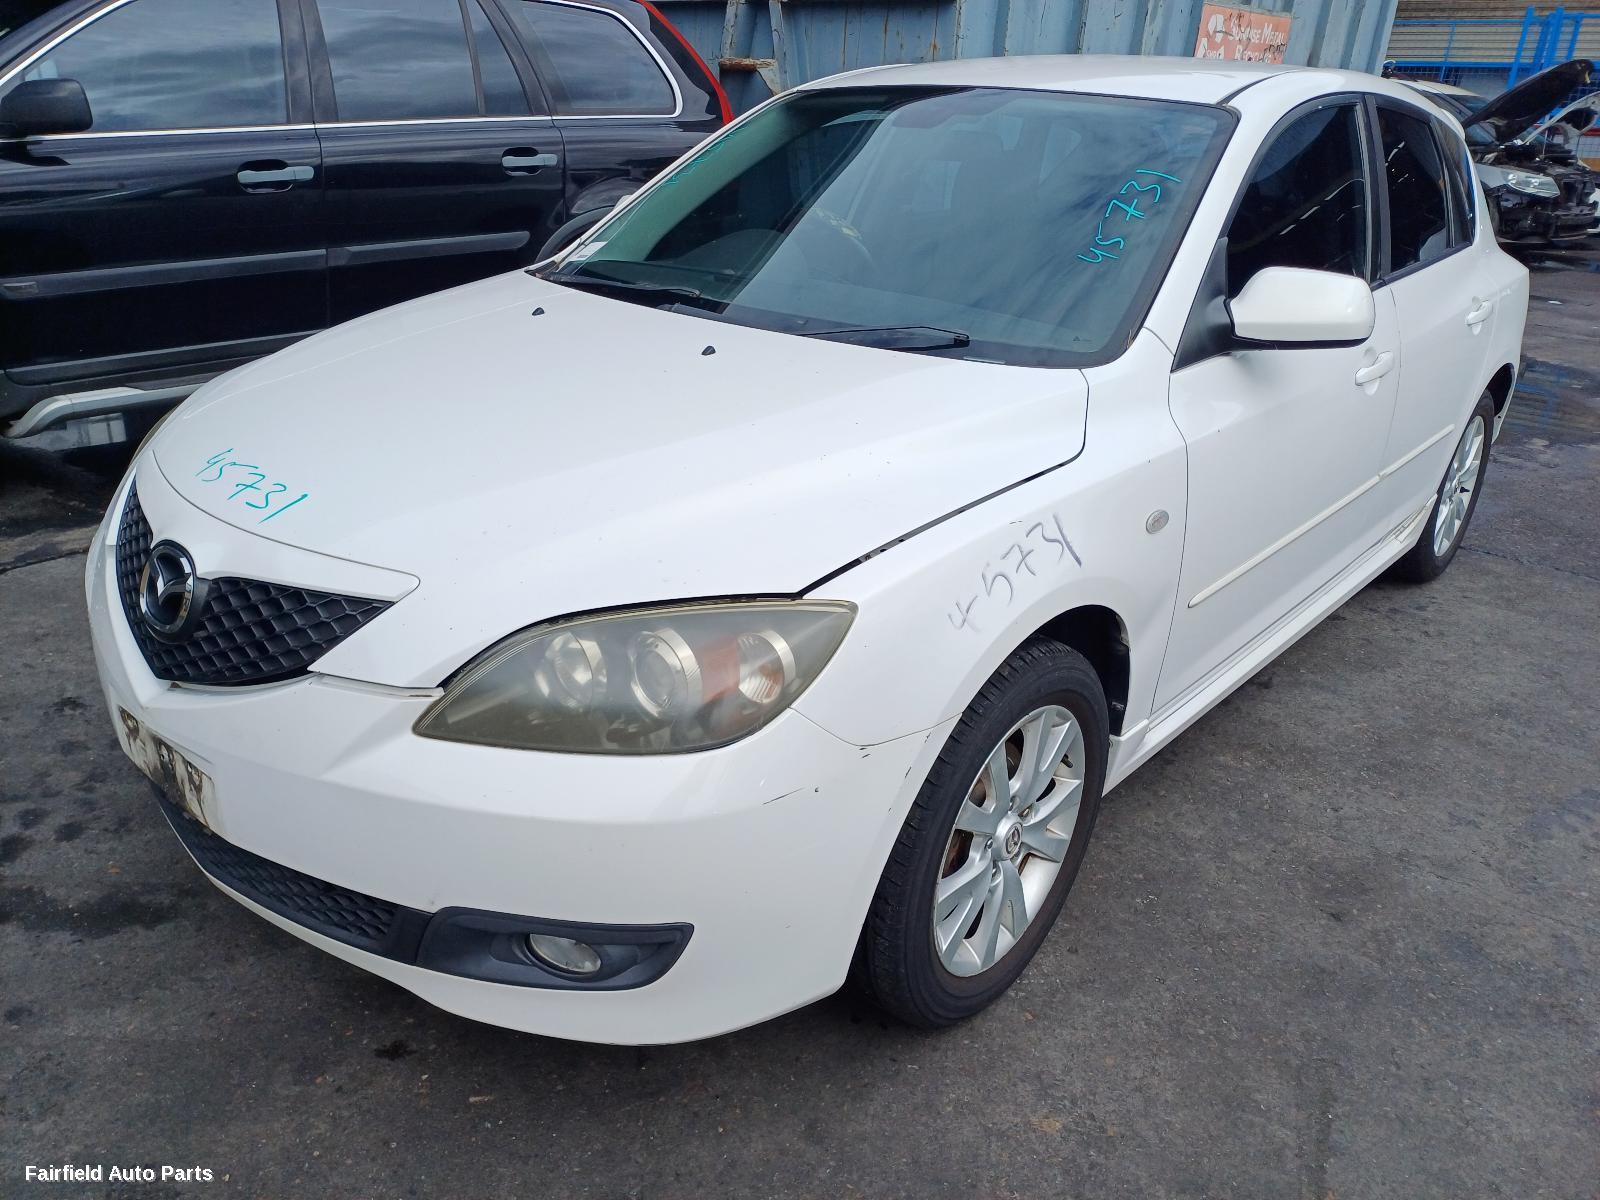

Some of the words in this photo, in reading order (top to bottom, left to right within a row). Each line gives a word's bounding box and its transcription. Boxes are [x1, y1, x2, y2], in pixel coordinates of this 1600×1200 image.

[1077, 168, 1182, 263] 45731
[195, 447, 308, 525] 45731
[947, 512, 1082, 634] 45731
